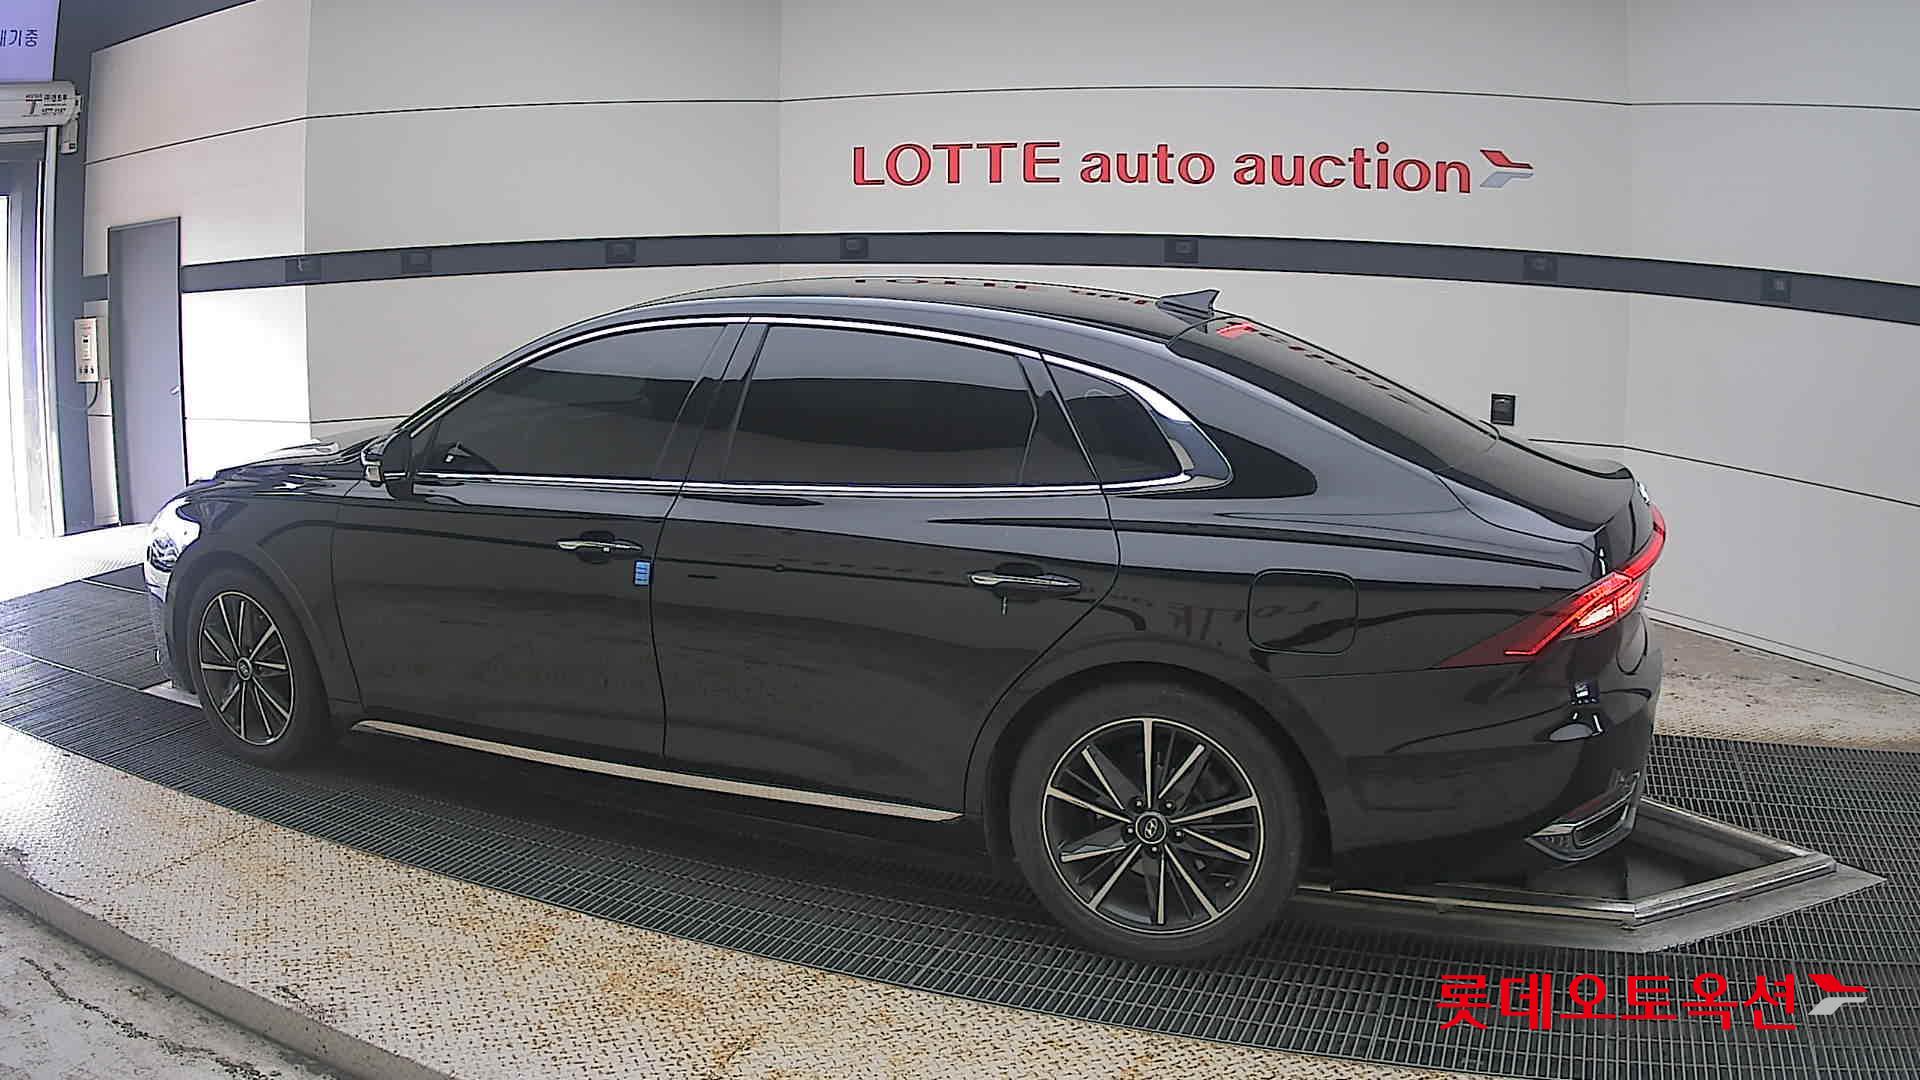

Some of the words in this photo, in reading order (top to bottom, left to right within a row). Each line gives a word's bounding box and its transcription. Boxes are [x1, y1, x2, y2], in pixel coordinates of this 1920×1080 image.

[853, 142, 1060, 186] LOTTE
[1079, 143, 1215, 185] auto
[1233, 141, 1472, 194] auction
